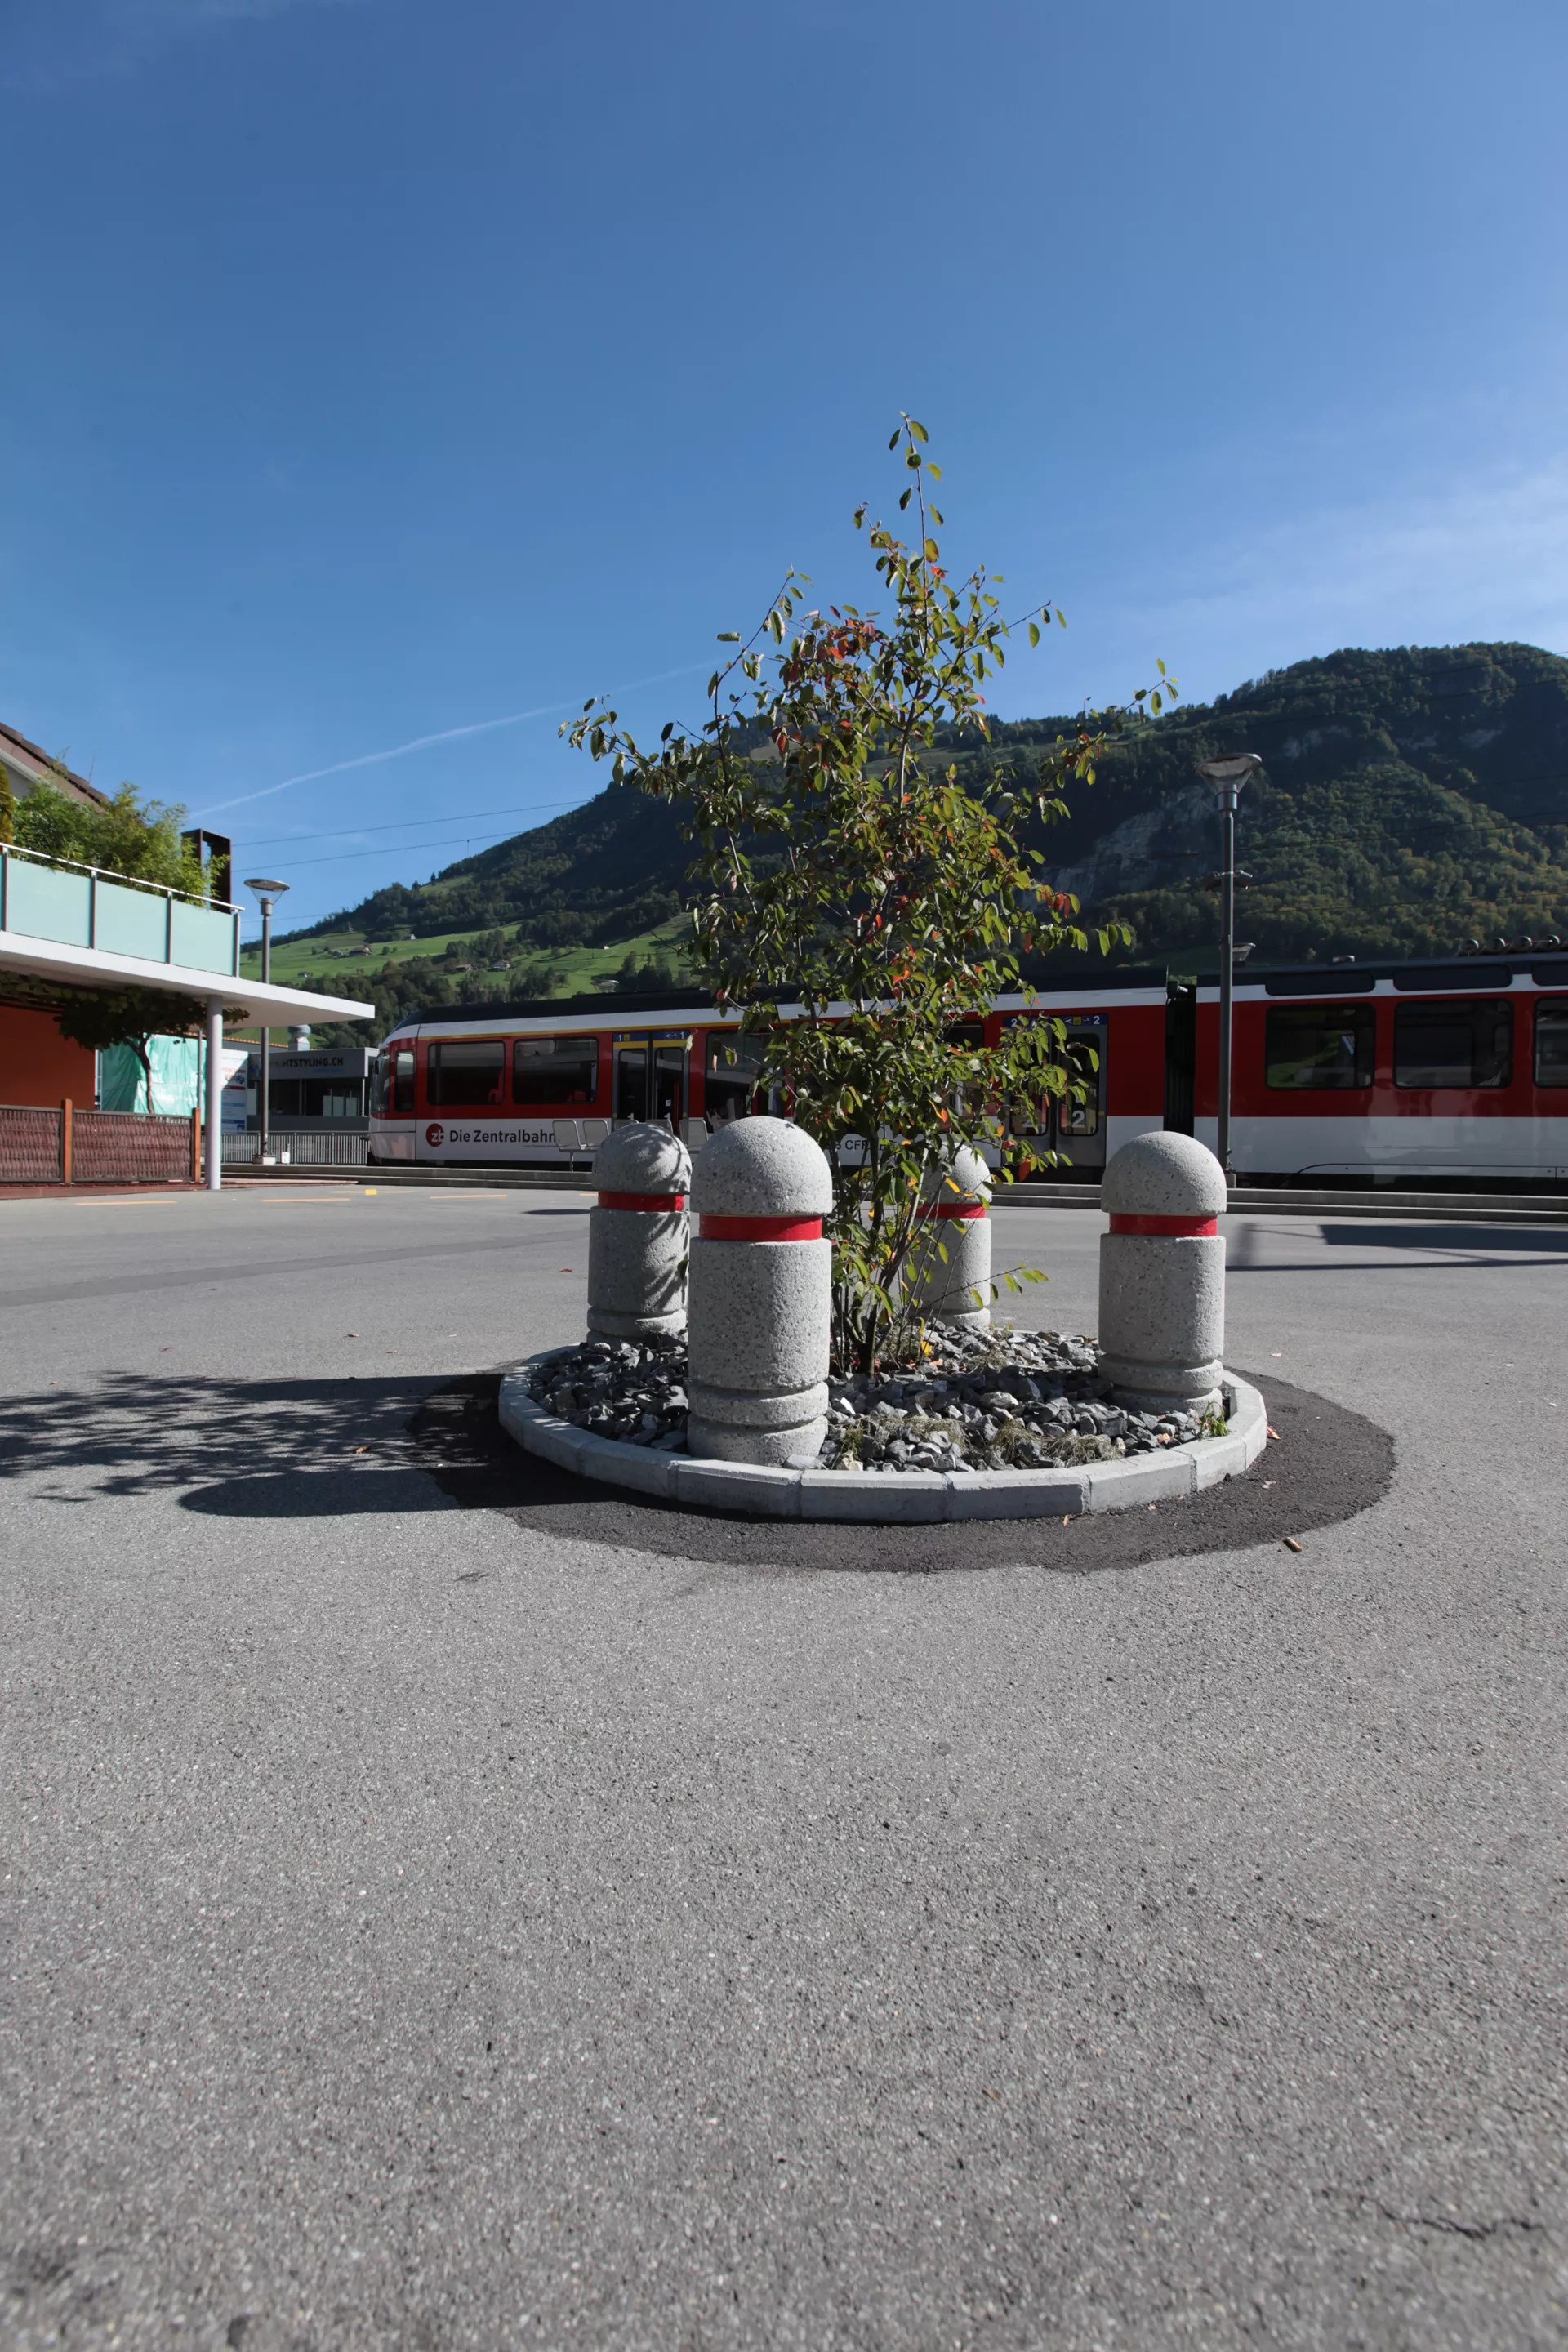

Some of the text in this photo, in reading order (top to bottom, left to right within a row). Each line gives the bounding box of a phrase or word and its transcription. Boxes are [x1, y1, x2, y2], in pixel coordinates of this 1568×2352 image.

[1011, 1018, 1018, 1027] 2
[1093, 1016, 1100, 1024] 2
[1072, 1111, 1085, 1128] 2
[431, 1129, 444, 1143] zb
[450, 1129, 556, 1143] Die Zentralbahn
